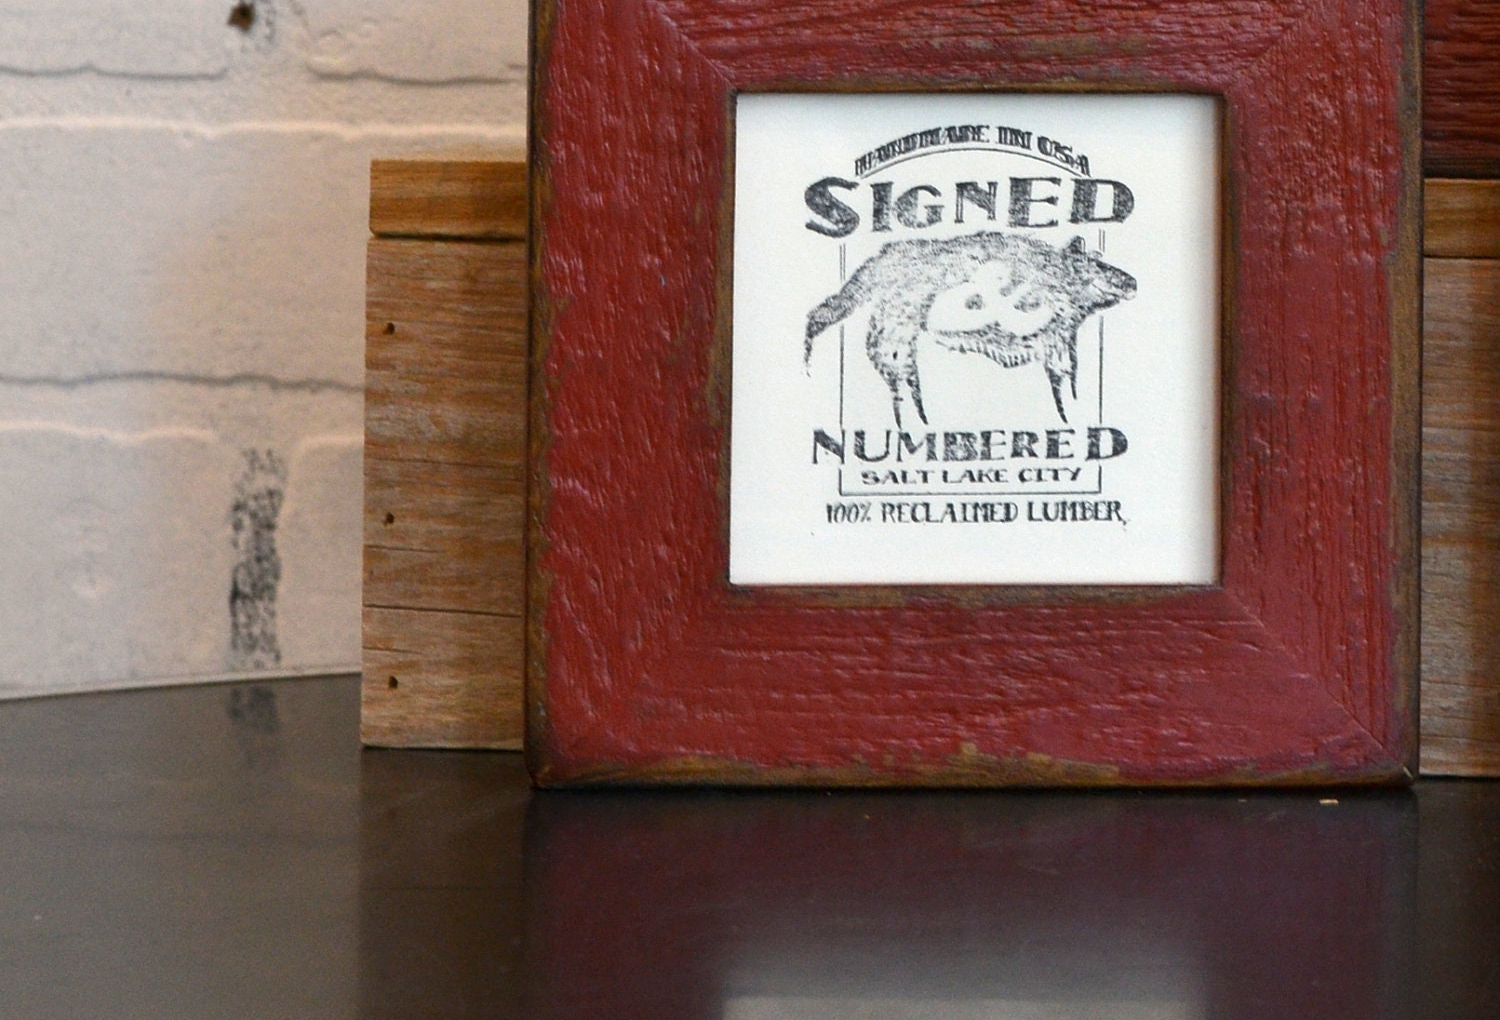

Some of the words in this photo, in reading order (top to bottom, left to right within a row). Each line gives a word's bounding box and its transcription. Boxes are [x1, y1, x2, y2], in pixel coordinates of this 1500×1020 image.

[997, 125, 1032, 151] IN
[1037, 136, 1091, 177] USA
[804, 176, 1135, 238] SIGNED
[812, 426, 1129, 465] NUMBERED
[861, 469, 934, 485] SALT
[942, 468, 1008, 484] LAKE
[1018, 466, 1082, 482] CITY
[825, 503, 872, 523] 100%
[881, 502, 1019, 524] RECLAIMED
